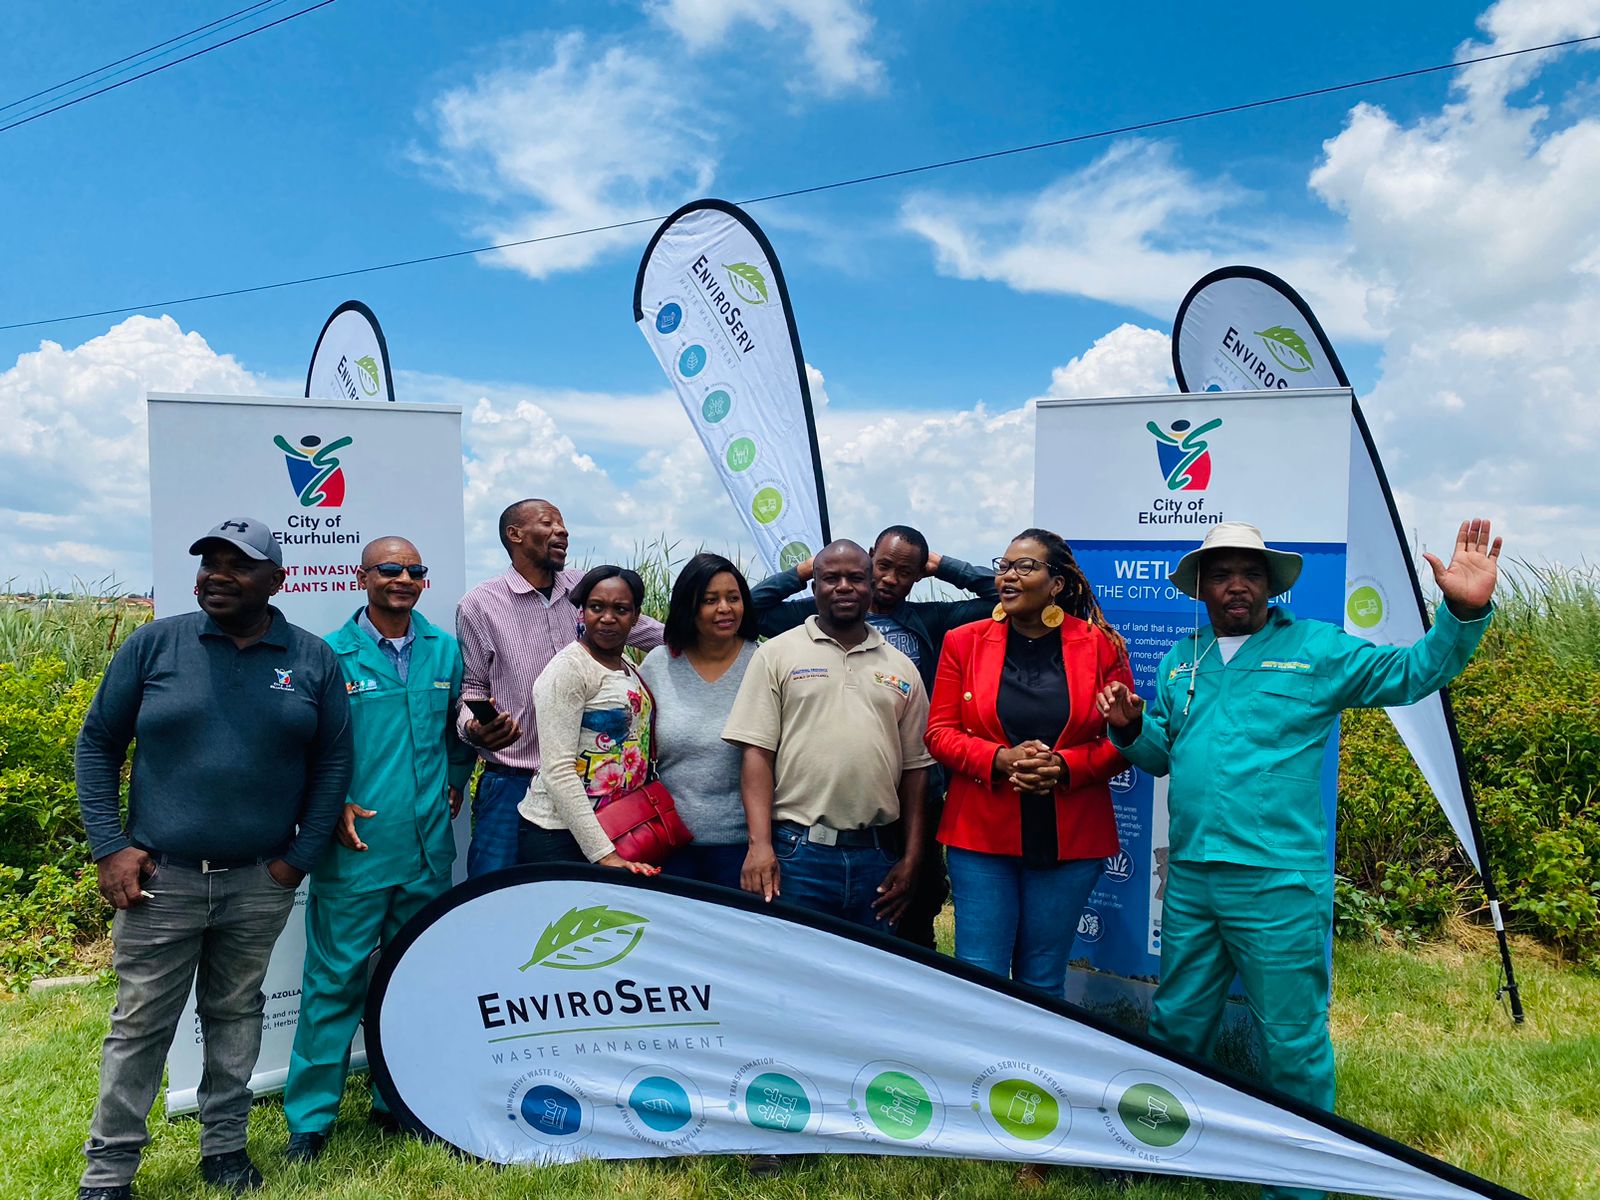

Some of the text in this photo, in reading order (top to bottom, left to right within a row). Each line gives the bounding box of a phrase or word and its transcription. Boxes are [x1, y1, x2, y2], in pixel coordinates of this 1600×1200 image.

[337, 355, 359, 400] ENVIR
[1153, 498, 1204, 513] City of
[287, 515, 341, 531] City of
[1138, 512, 1223, 525] Ekurhuleni
[272, 531, 360, 545] Ekurhuleni
[303, 564, 362, 576] INVASIV
[332, 582, 345, 591] IN
[1096, 585, 1123, 599] THE
[1128, 586, 1161, 600] CITY
[1123, 623, 1130, 631] of
[1132, 623, 1148, 632] land
[1151, 624, 1165, 632] that
[271, 989, 302, 999] AZOLLA
[477, 979, 711, 1029] ENVIROSERV
[272, 1010, 286, 1019] and
[492, 1036, 725, 1065] WASTE MANAGEMENT
[997, 1060, 1031, 1072] SERVICE
[730, 1057, 774, 1097] TRANSFORMATION
[506, 1074, 528, 1111] INNOVATIVE
[527, 1068, 551, 1079] WASTE
[852, 1111, 870, 1140] SOCIAL
[1102, 1115, 1161, 1164] CUSTOMER CARE
